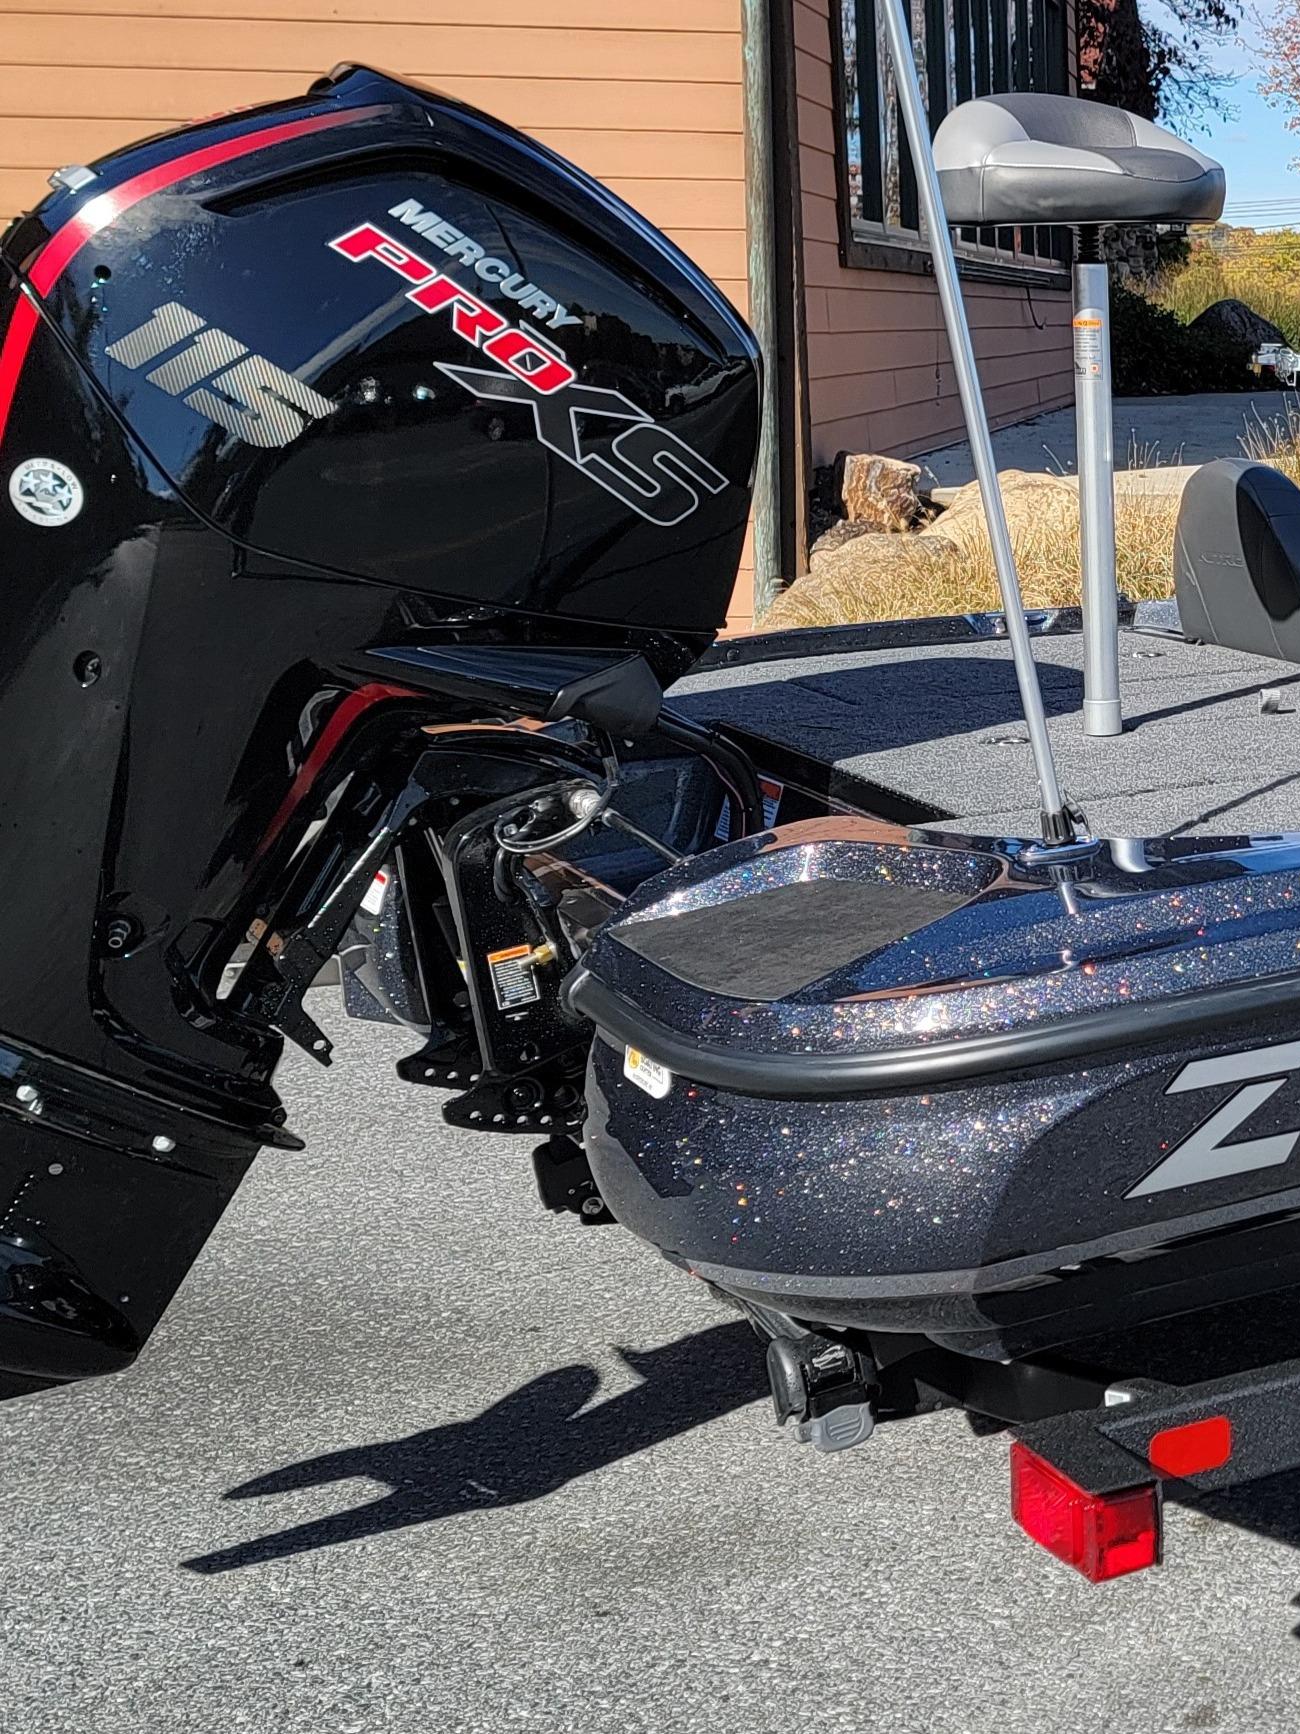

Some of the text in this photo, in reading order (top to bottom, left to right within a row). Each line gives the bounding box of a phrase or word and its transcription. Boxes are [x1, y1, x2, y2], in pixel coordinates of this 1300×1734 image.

[328, 222, 578, 396] PRO
[388, 198, 583, 331] MERCURY
[104, 301, 338, 449] 115
[433, 320, 730, 527] XS
